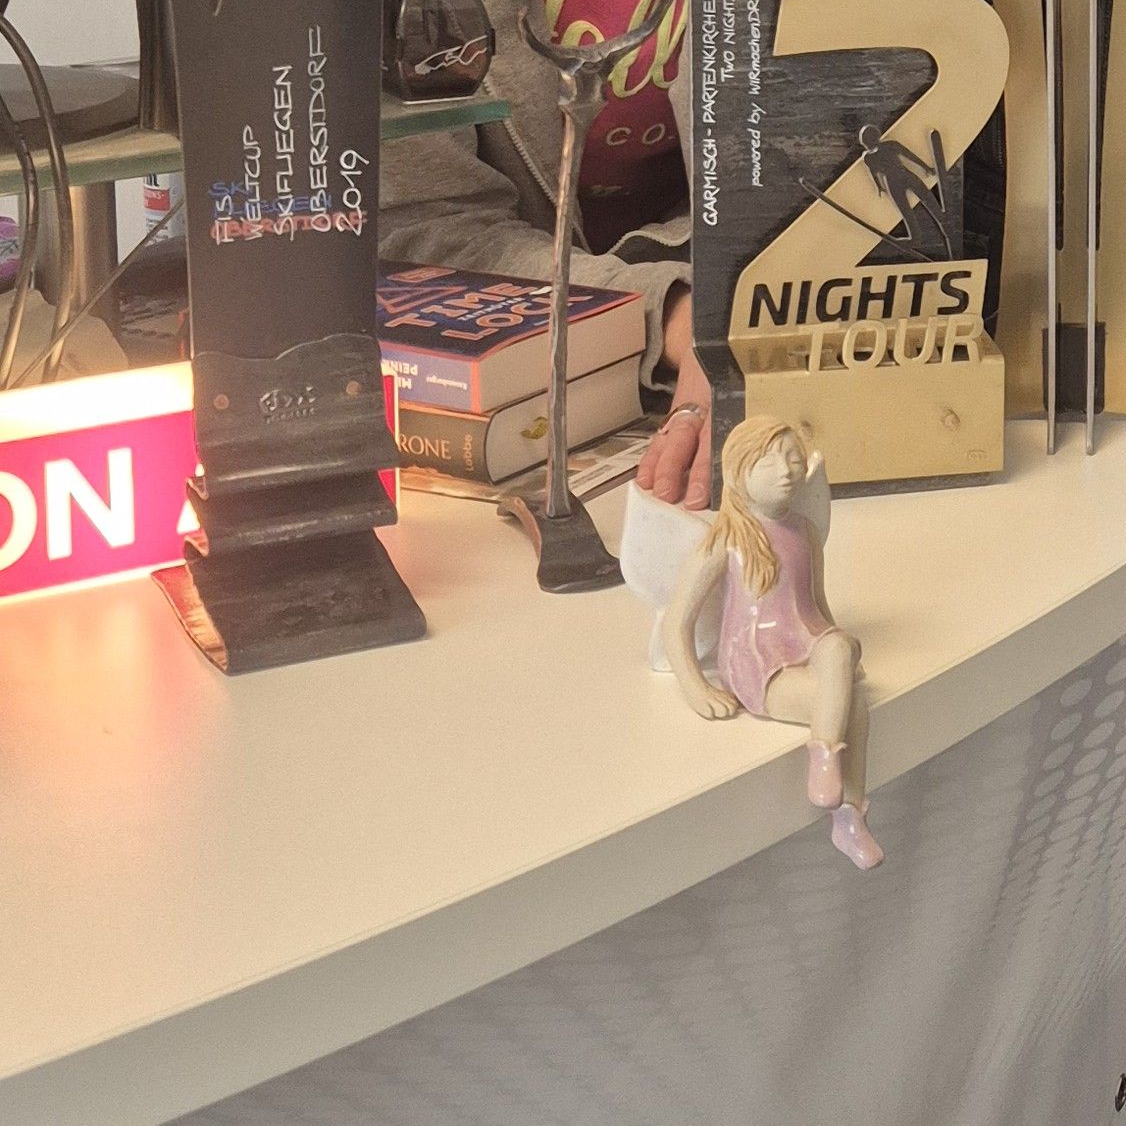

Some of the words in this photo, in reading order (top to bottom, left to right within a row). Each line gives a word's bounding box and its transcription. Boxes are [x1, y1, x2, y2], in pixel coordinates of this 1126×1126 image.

[308, 25, 332, 233] OBERSTDORF
[747, 102, 766, 124] by
[747, 128, 763, 187] powered
[336, 149, 370, 236] 2019
[749, 270, 972, 328] NIGHTS
[800, 313, 985, 374] TOUR
[399, 433, 452, 460] RONE
